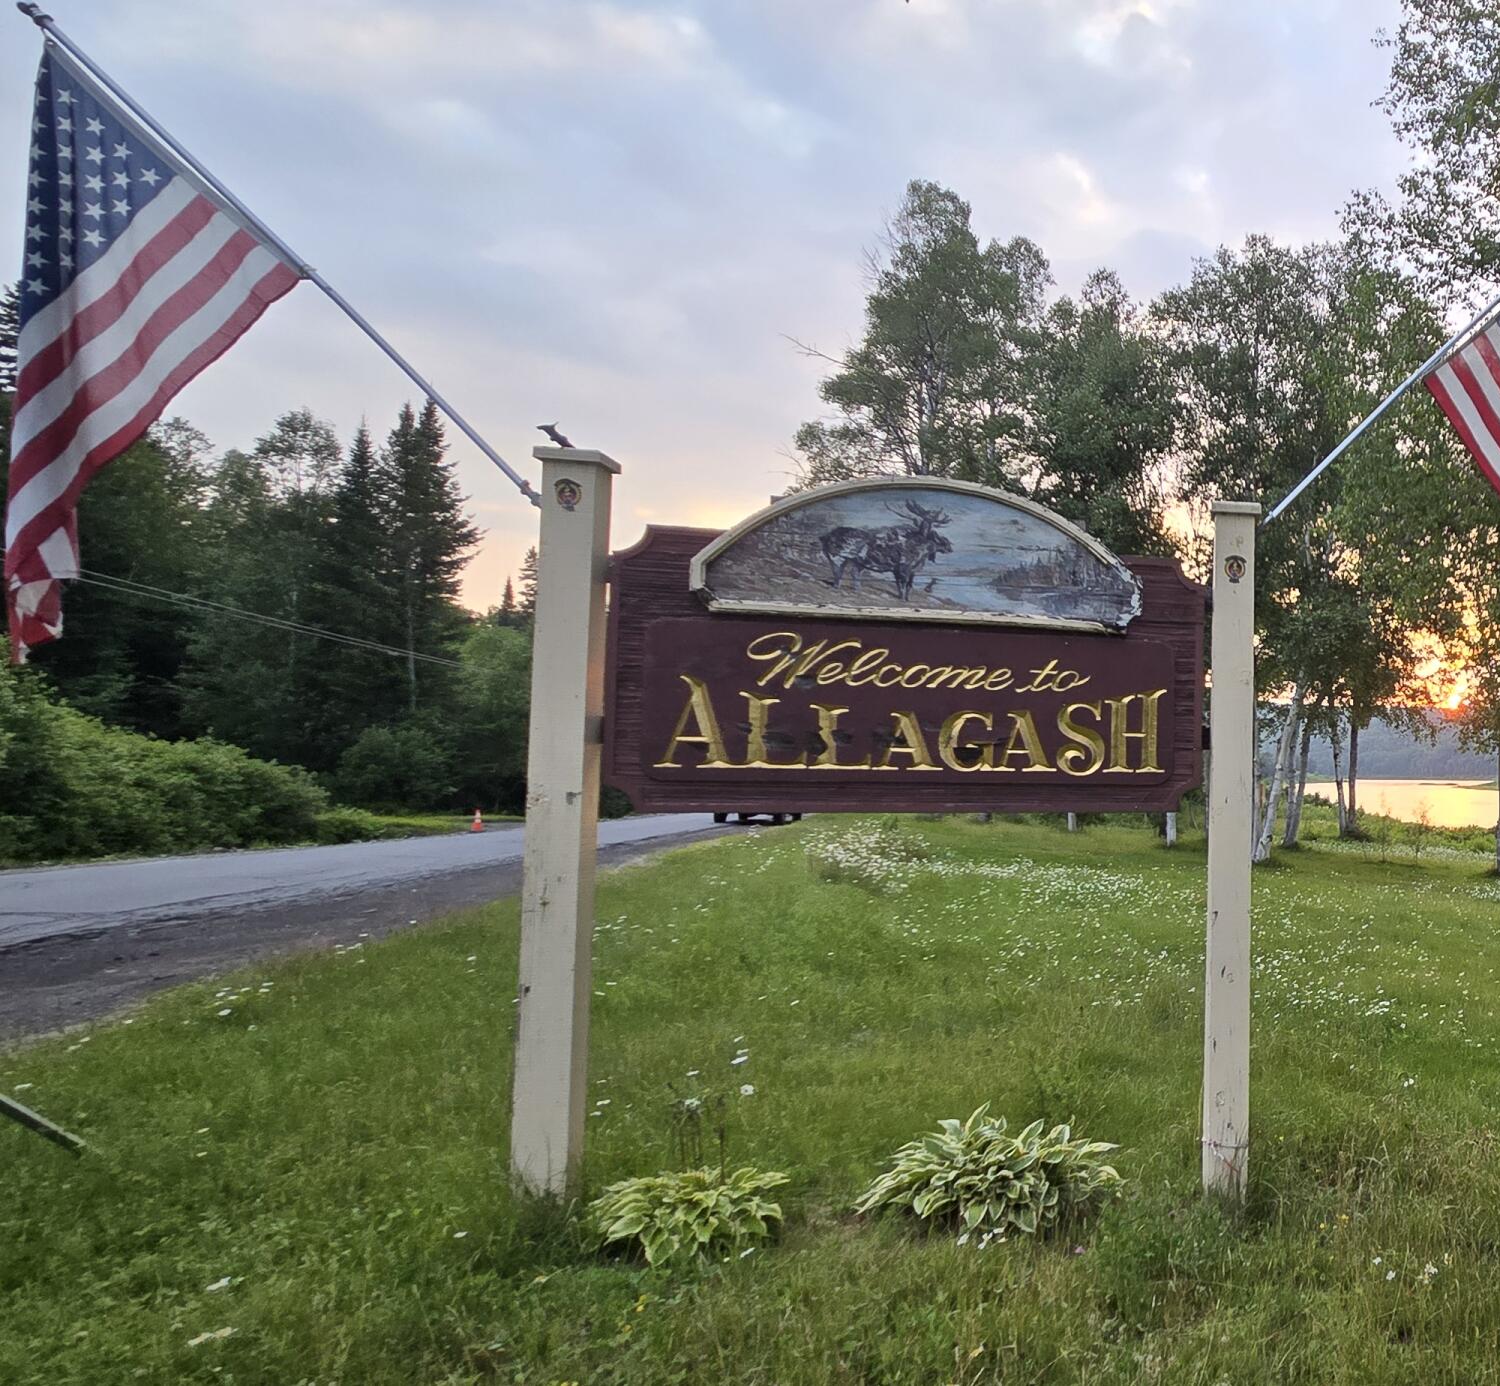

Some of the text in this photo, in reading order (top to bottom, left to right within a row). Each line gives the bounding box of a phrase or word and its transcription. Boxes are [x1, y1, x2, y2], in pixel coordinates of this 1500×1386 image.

[746, 632, 1091, 693] Welcome to
[653, 675, 1168, 776] ALLAGASH
